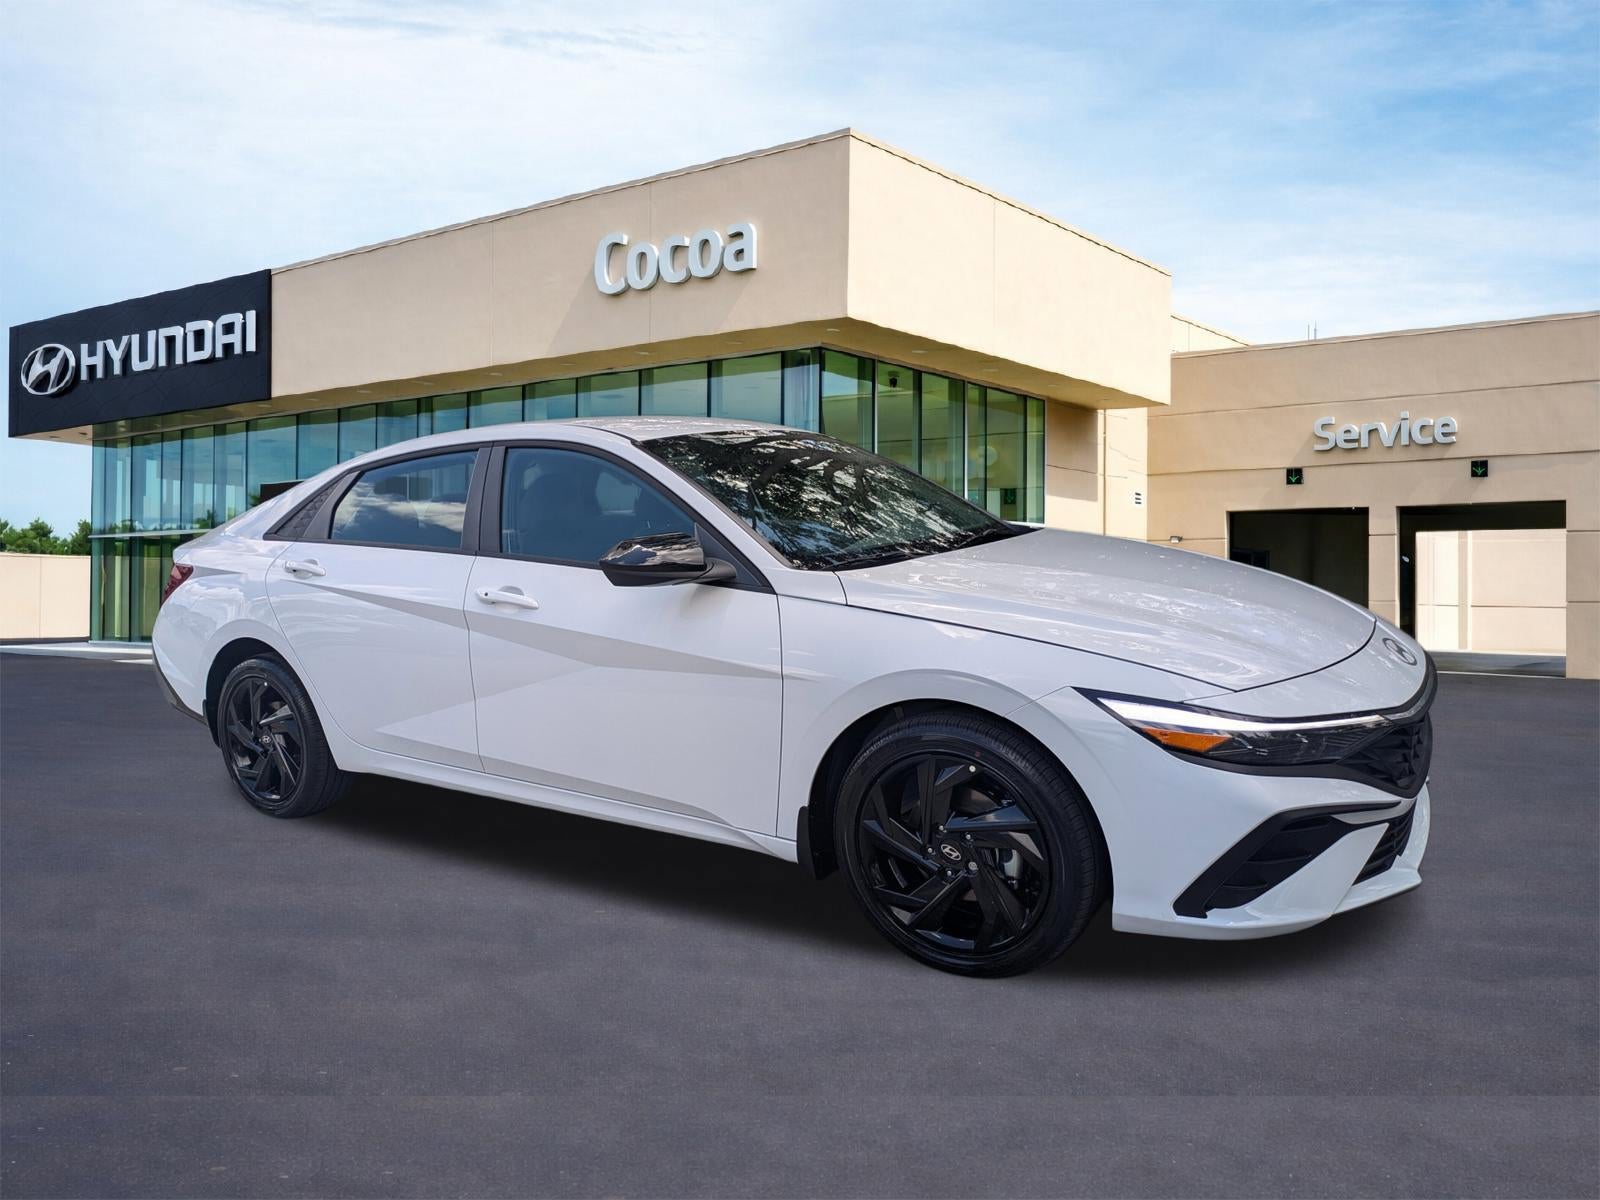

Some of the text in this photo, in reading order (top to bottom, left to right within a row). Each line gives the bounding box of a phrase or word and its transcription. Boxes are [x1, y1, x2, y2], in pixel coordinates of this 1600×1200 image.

[594, 222, 757, 296] Cocoa
[80, 309, 257, 381] HYUNDAI
[1312, 410, 1458, 451] Service
